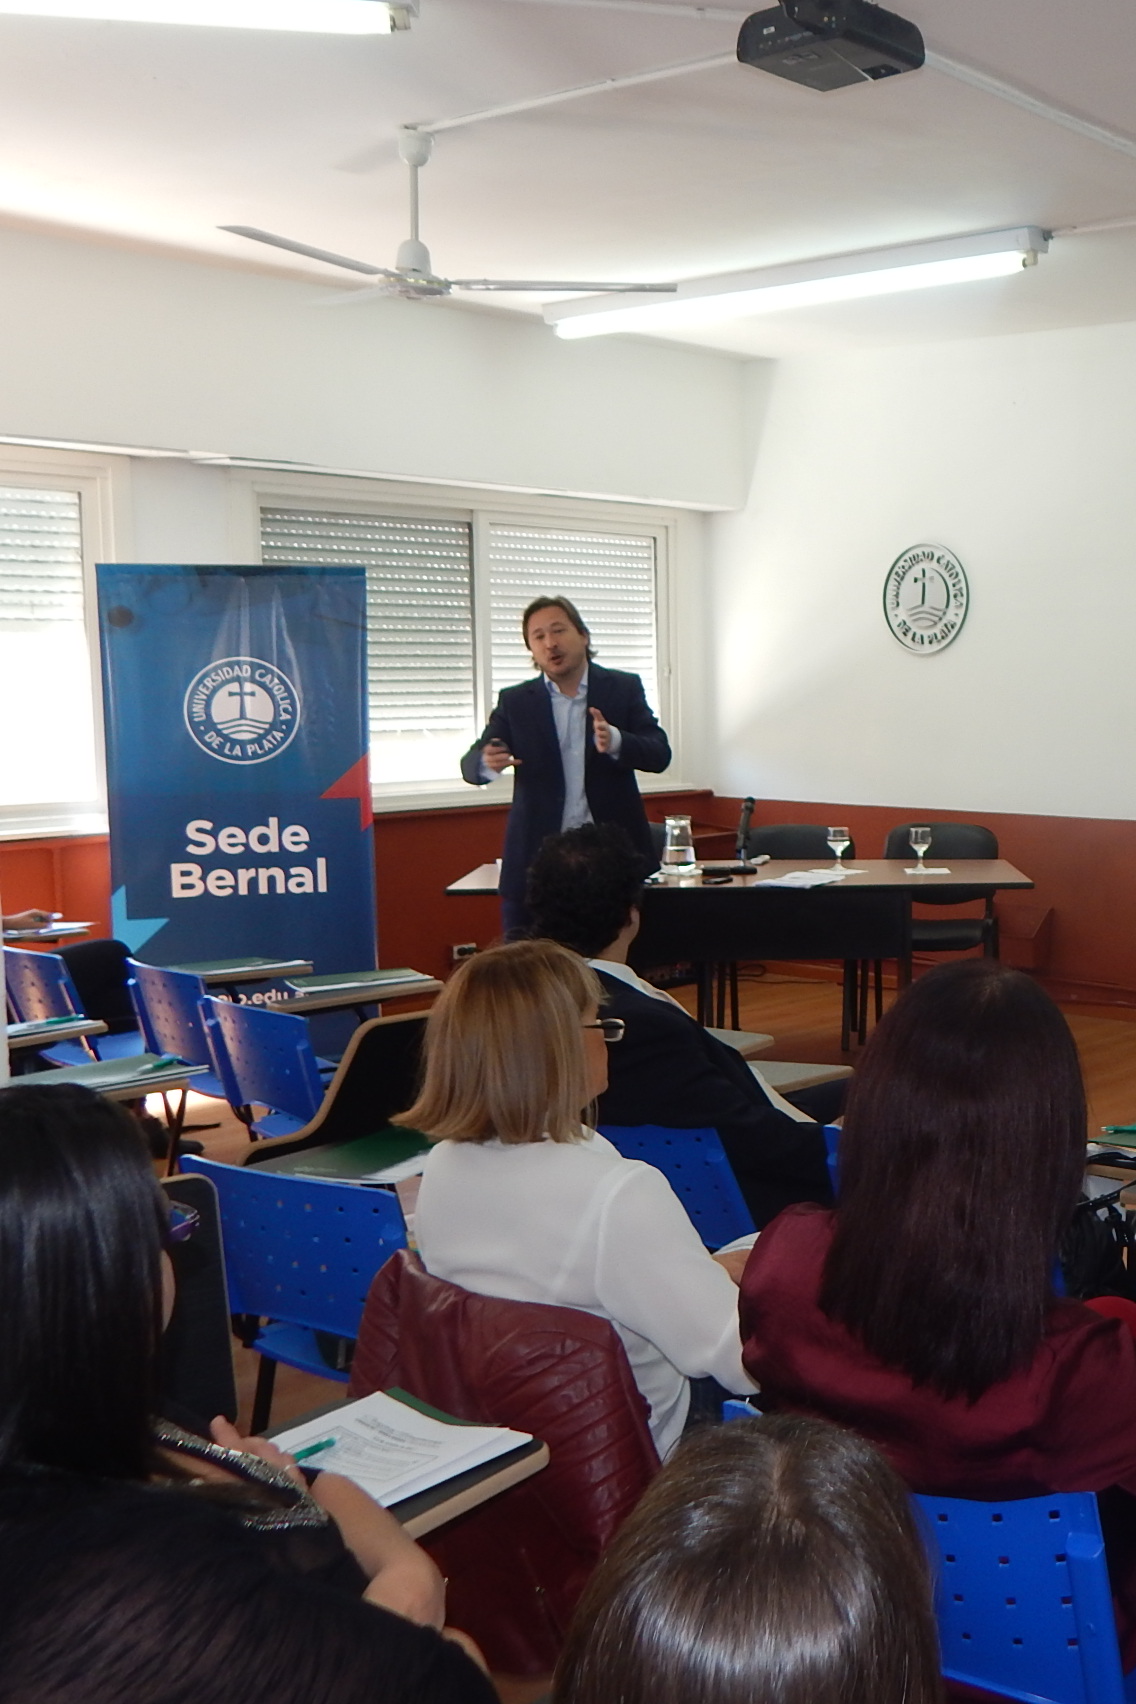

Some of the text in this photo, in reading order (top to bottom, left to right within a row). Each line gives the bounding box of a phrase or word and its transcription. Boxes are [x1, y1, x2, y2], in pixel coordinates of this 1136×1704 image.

[192, 664, 251, 722] UNIVERSIDAD
[204, 730, 285, 757] DE LA PLATA
[185, 816, 310, 856] Sede
[170, 857, 328, 898] Bernal
